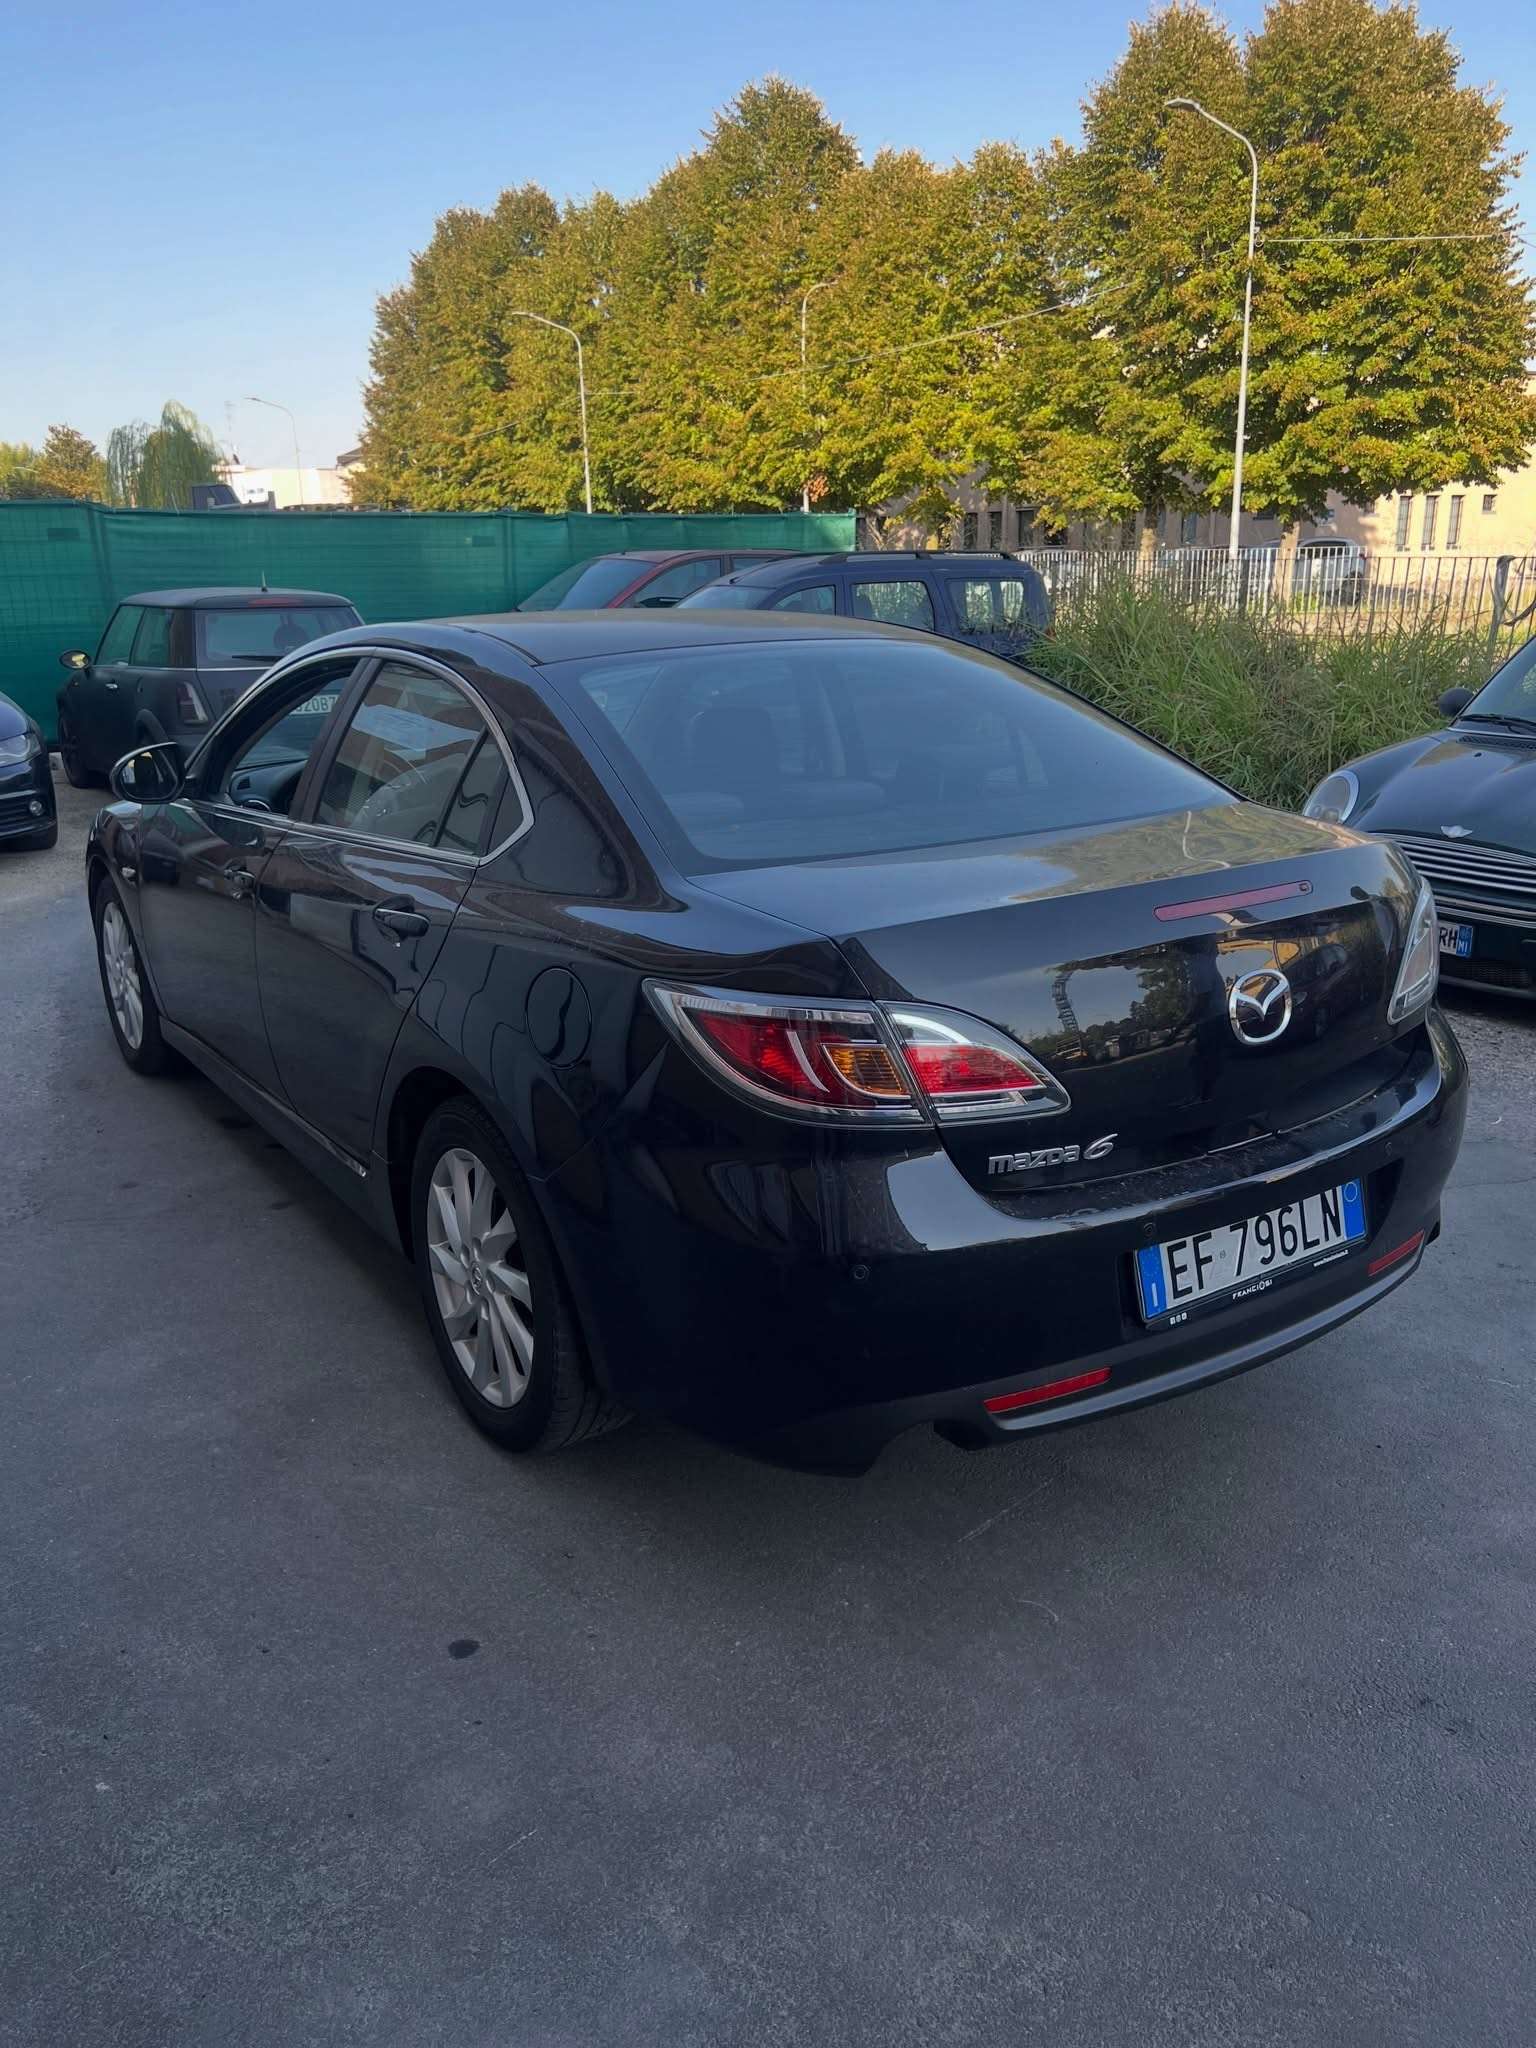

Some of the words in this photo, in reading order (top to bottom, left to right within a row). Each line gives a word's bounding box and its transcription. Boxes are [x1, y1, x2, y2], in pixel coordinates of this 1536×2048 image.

[1083, 1133, 1118, 1160] 6
[1166, 1232, 1213, 1299] EF
[1229, 1187, 1342, 1277] 796LN
